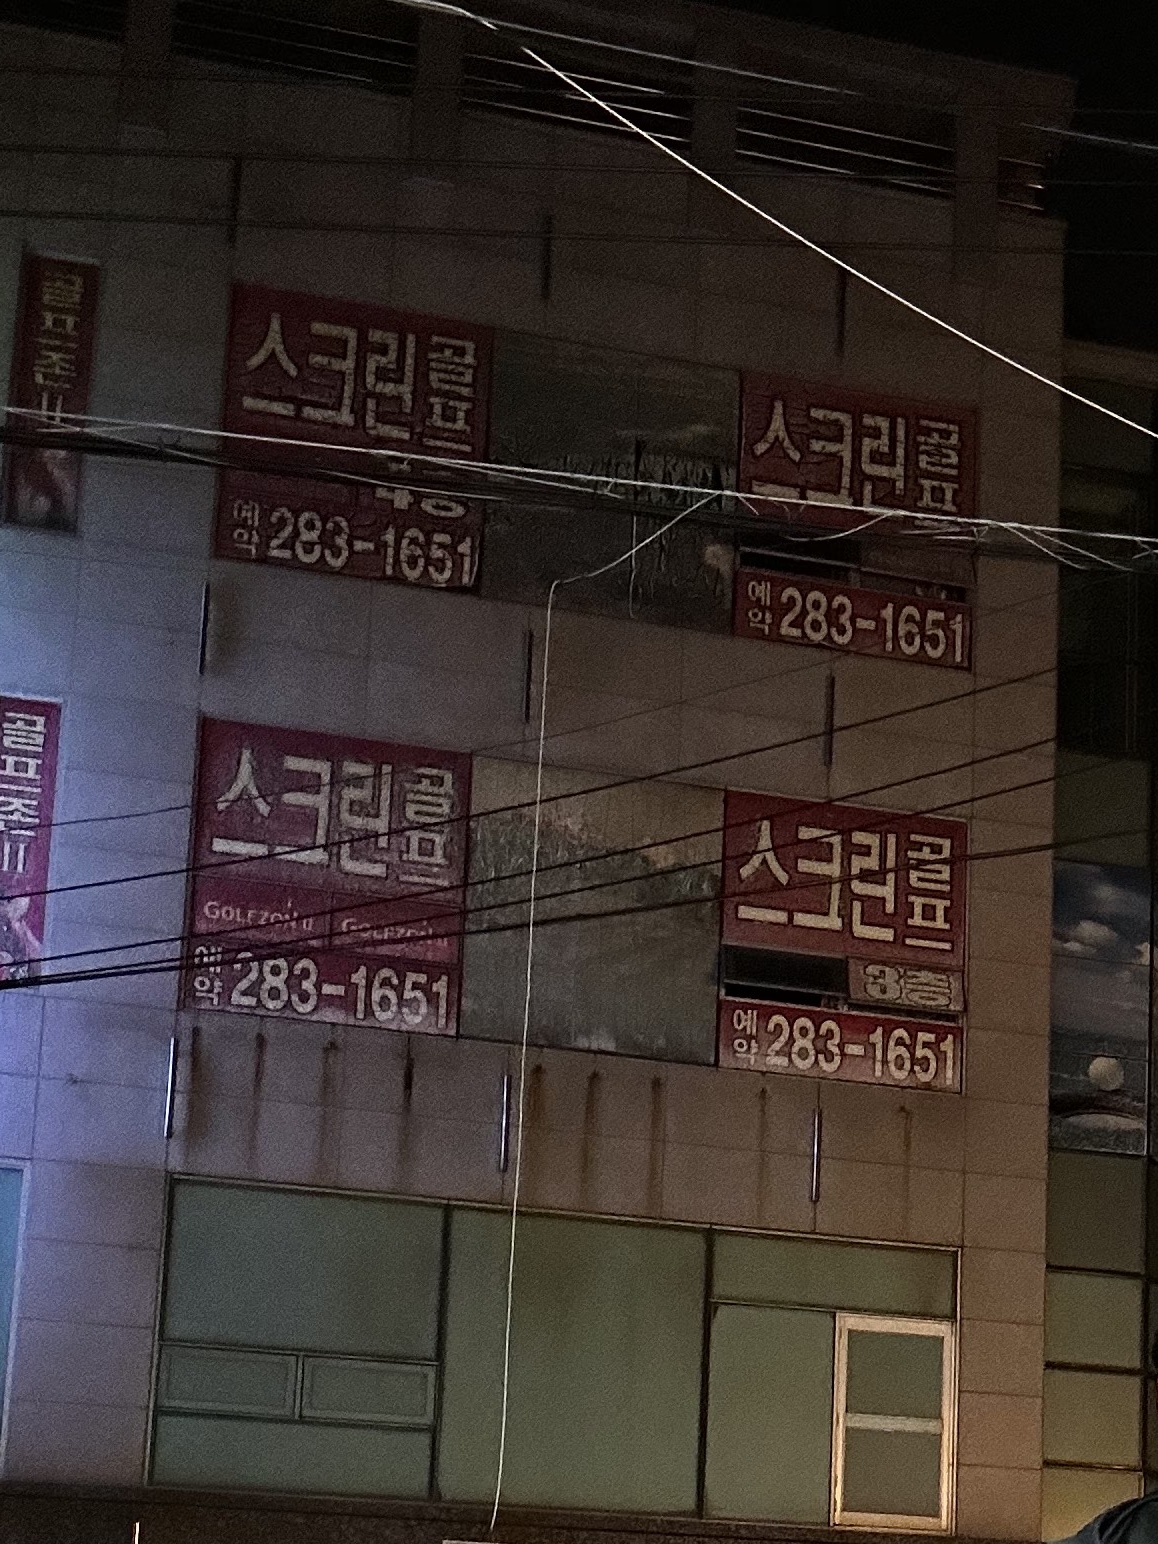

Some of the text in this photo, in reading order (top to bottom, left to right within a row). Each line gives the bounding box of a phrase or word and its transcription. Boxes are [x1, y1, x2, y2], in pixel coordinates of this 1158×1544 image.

[266, 505, 473, 586] 283-1651
[747, 579, 965, 663] 예약 283-1651
[230, 952, 450, 1030] 283-1651
[732, 1008, 955, 1086] 예약 283-1651
